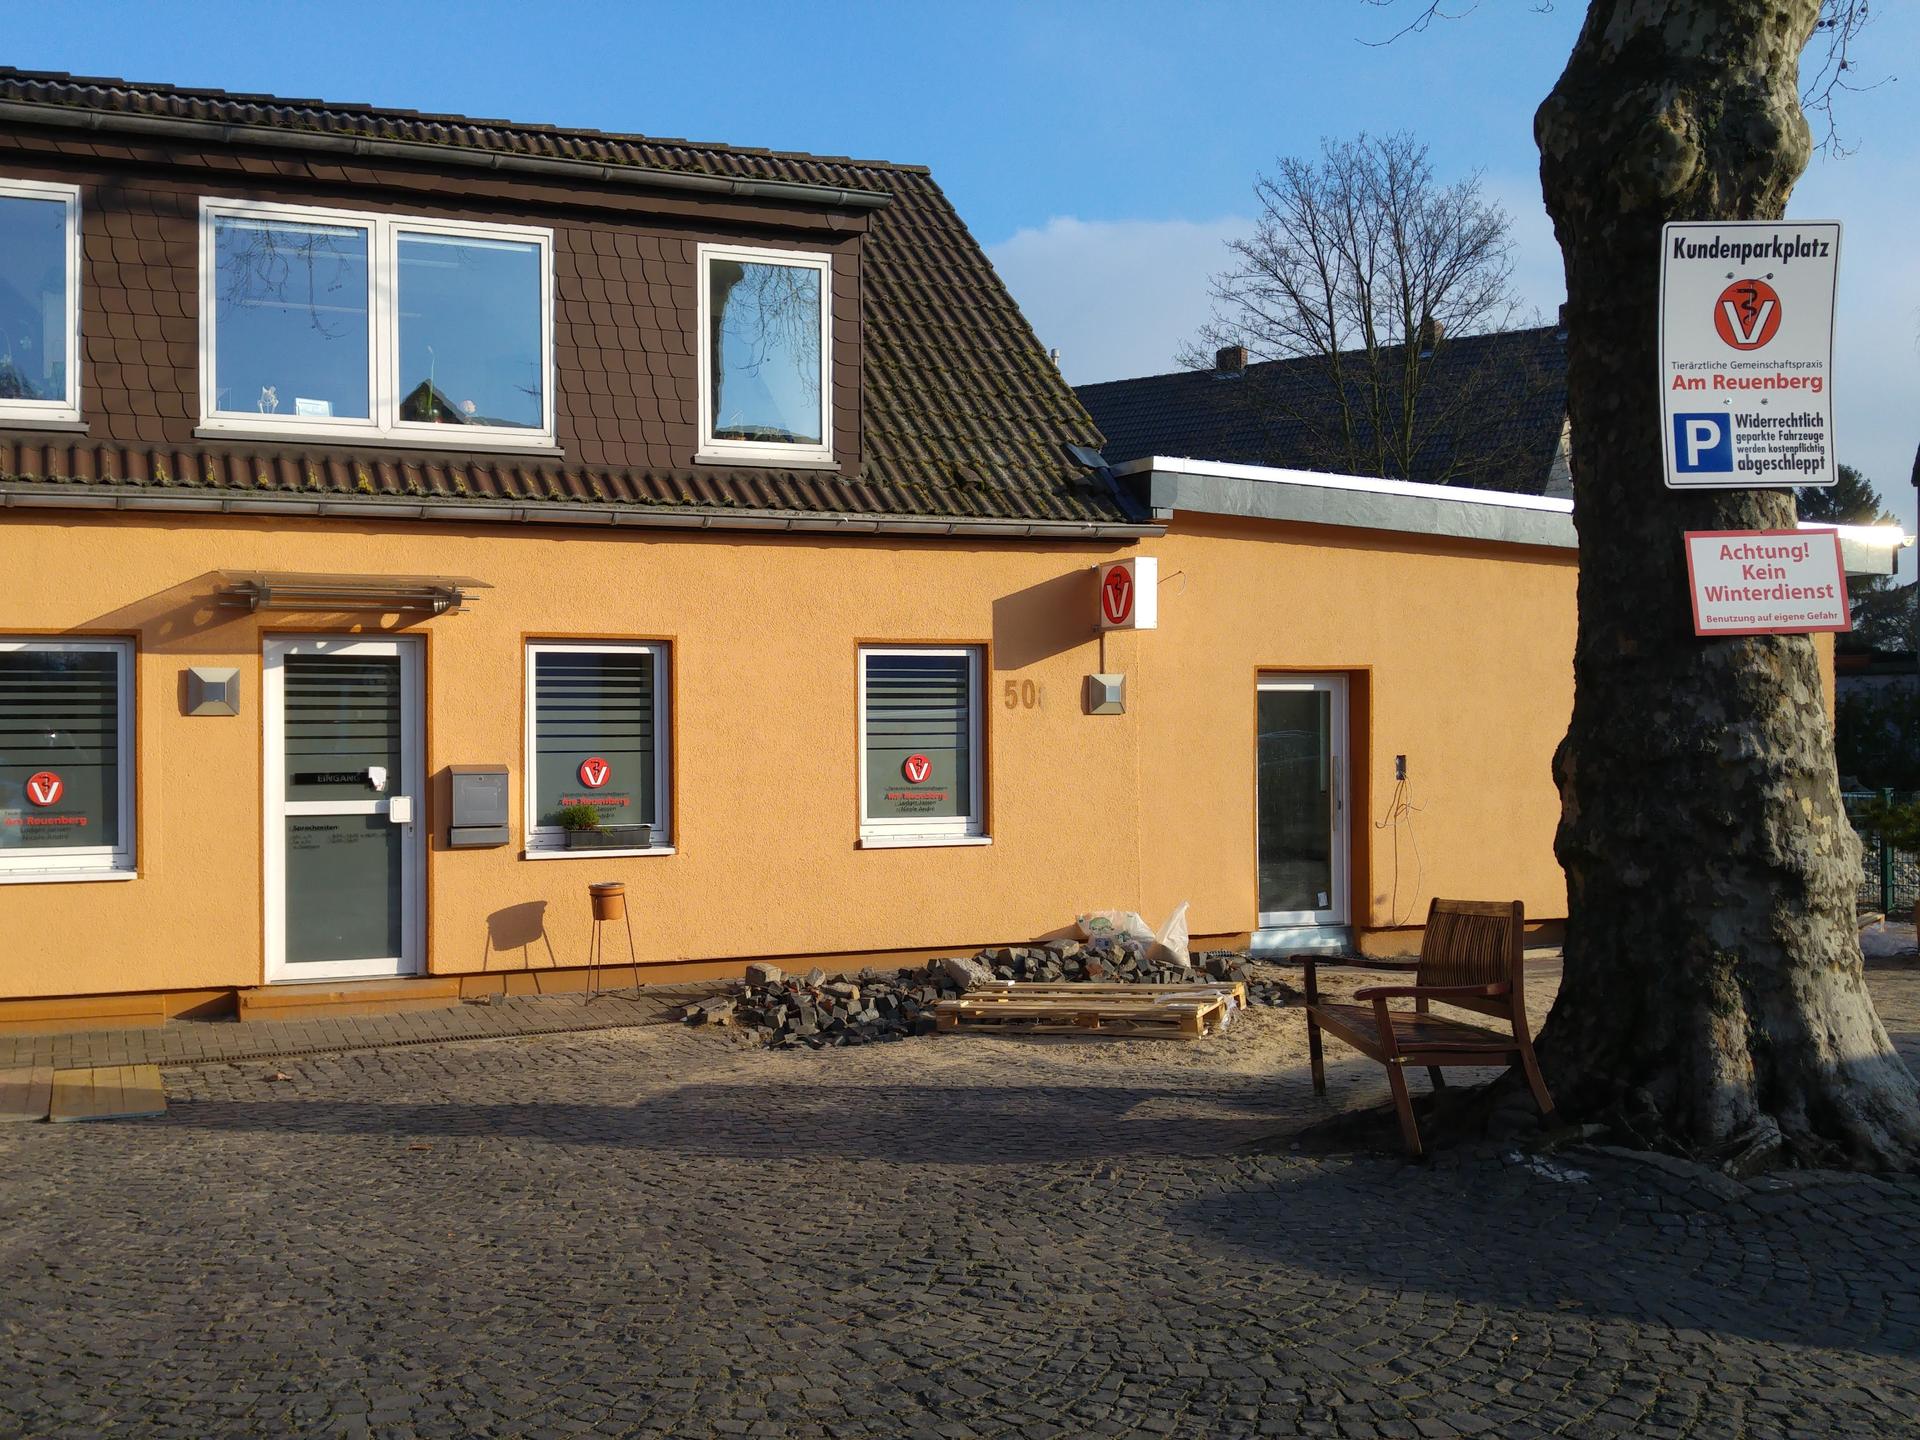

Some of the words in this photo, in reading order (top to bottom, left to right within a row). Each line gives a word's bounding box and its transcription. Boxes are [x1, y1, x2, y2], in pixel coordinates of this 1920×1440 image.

[1673, 235, 1829, 265] Kundenparkplatz
[1671, 359, 1728, 371] Tierärztliche
[1730, 358, 1823, 371] Gemeinschaftspraxis
[1672, 374, 1707, 391] Am
[1712, 373, 1823, 393] Reuenberg
[1735, 412, 1824, 429] Widerrechtlich
[1685, 419, 1721, 466] P
[1736, 429, 1776, 444] geparkte
[1778, 429, 1824, 444] Fahrzeuge
[1737, 443, 1767, 454] werden
[1768, 443, 1826, 456] kostenpflichtig
[1738, 454, 1826, 475] abgeschleppt
[1719, 542, 1810, 563] Achtung!
[1742, 564, 1786, 580] Kein
[1704, 583, 1835, 602] Winterdienst
[1706, 614, 1756, 624] Benutzung
[1757, 613, 1773, 622] auf
[1774, 612, 1805, 622] eigene
[1807, 610, 1838, 621] Gefahr
